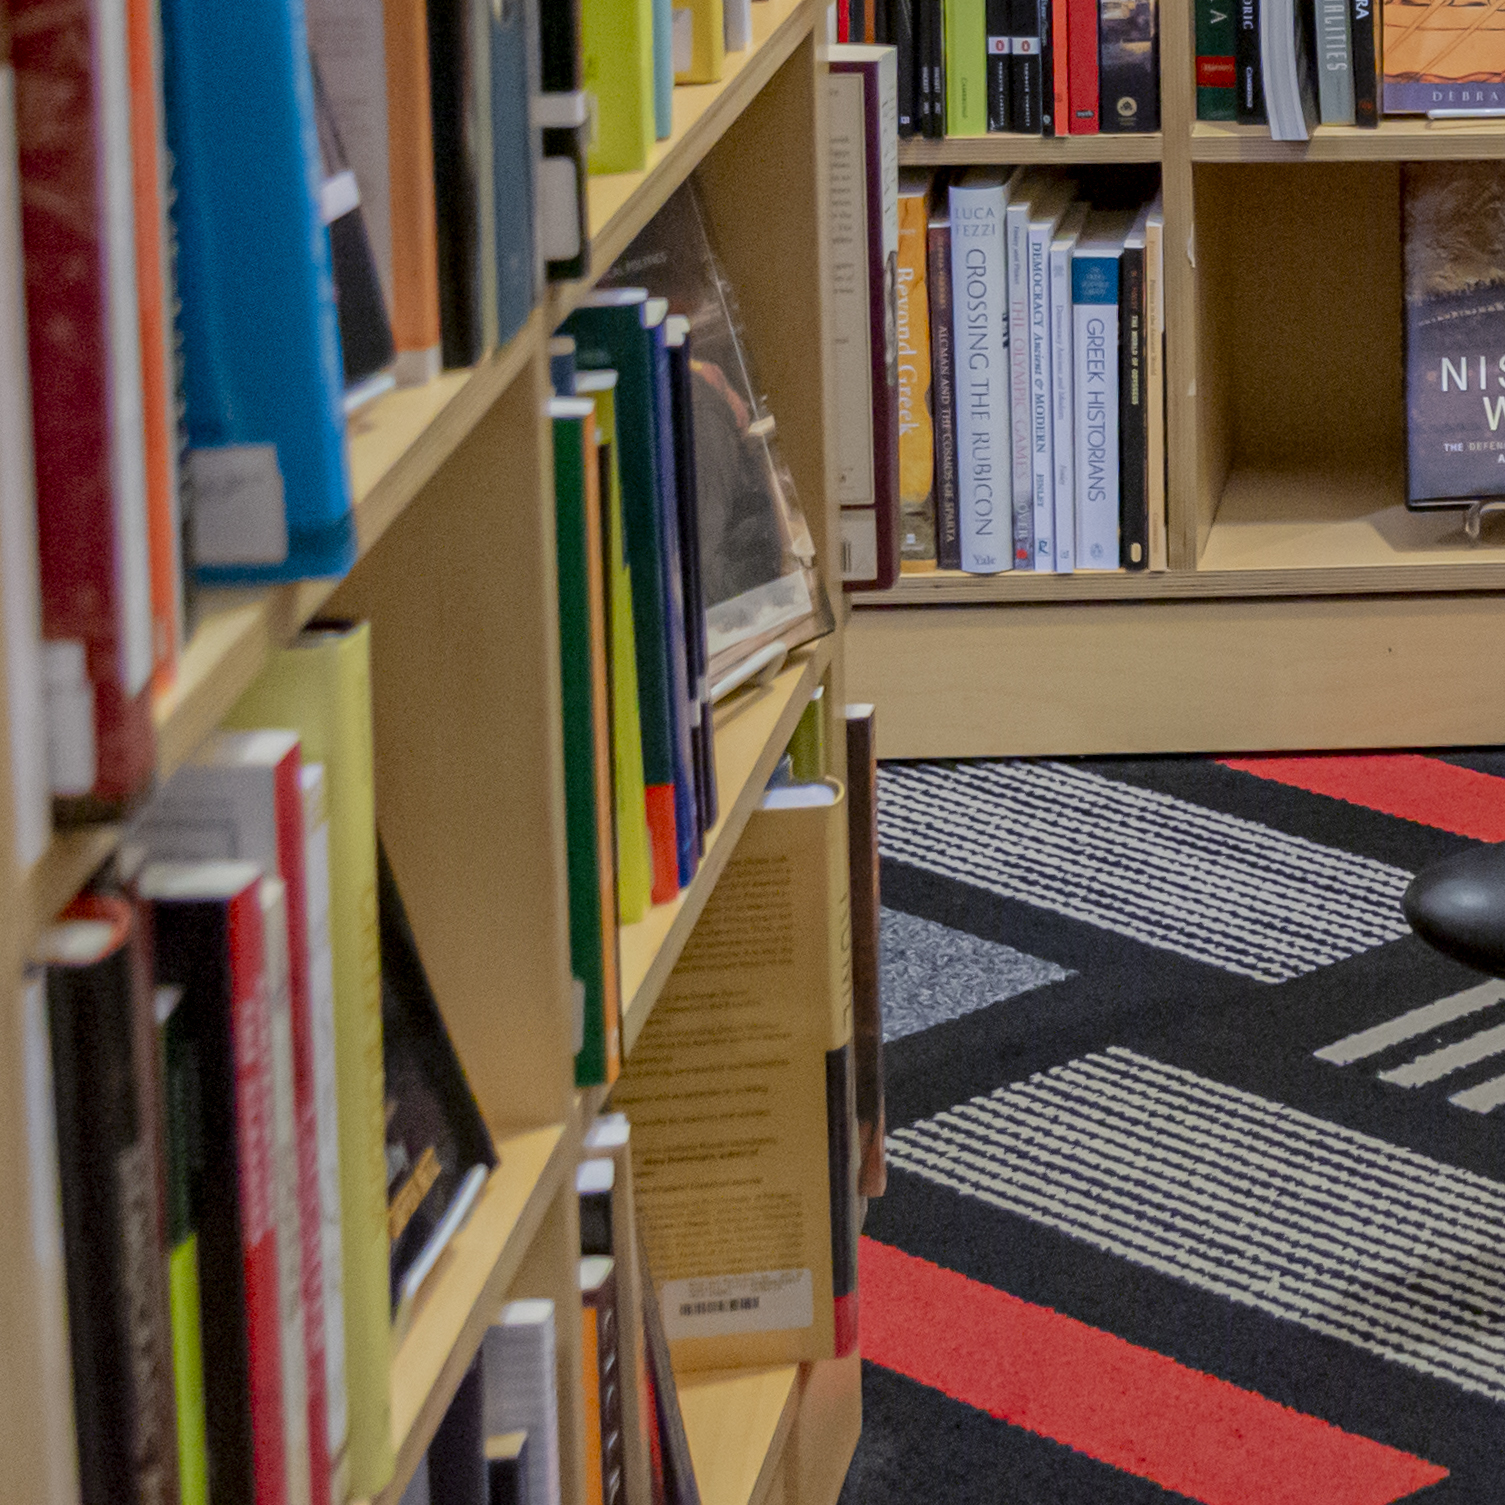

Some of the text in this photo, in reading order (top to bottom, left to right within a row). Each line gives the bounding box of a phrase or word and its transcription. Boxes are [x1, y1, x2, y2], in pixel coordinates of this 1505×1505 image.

[1432, 90, 1499, 103] DEBRA
[1130, 315, 1138, 328] THE
[1131, 357, 1138, 367] OF
[965, 249, 994, 536] CROSSING THE RUBICON
[1086, 318, 1107, 502] GREEK HISTORIANS
